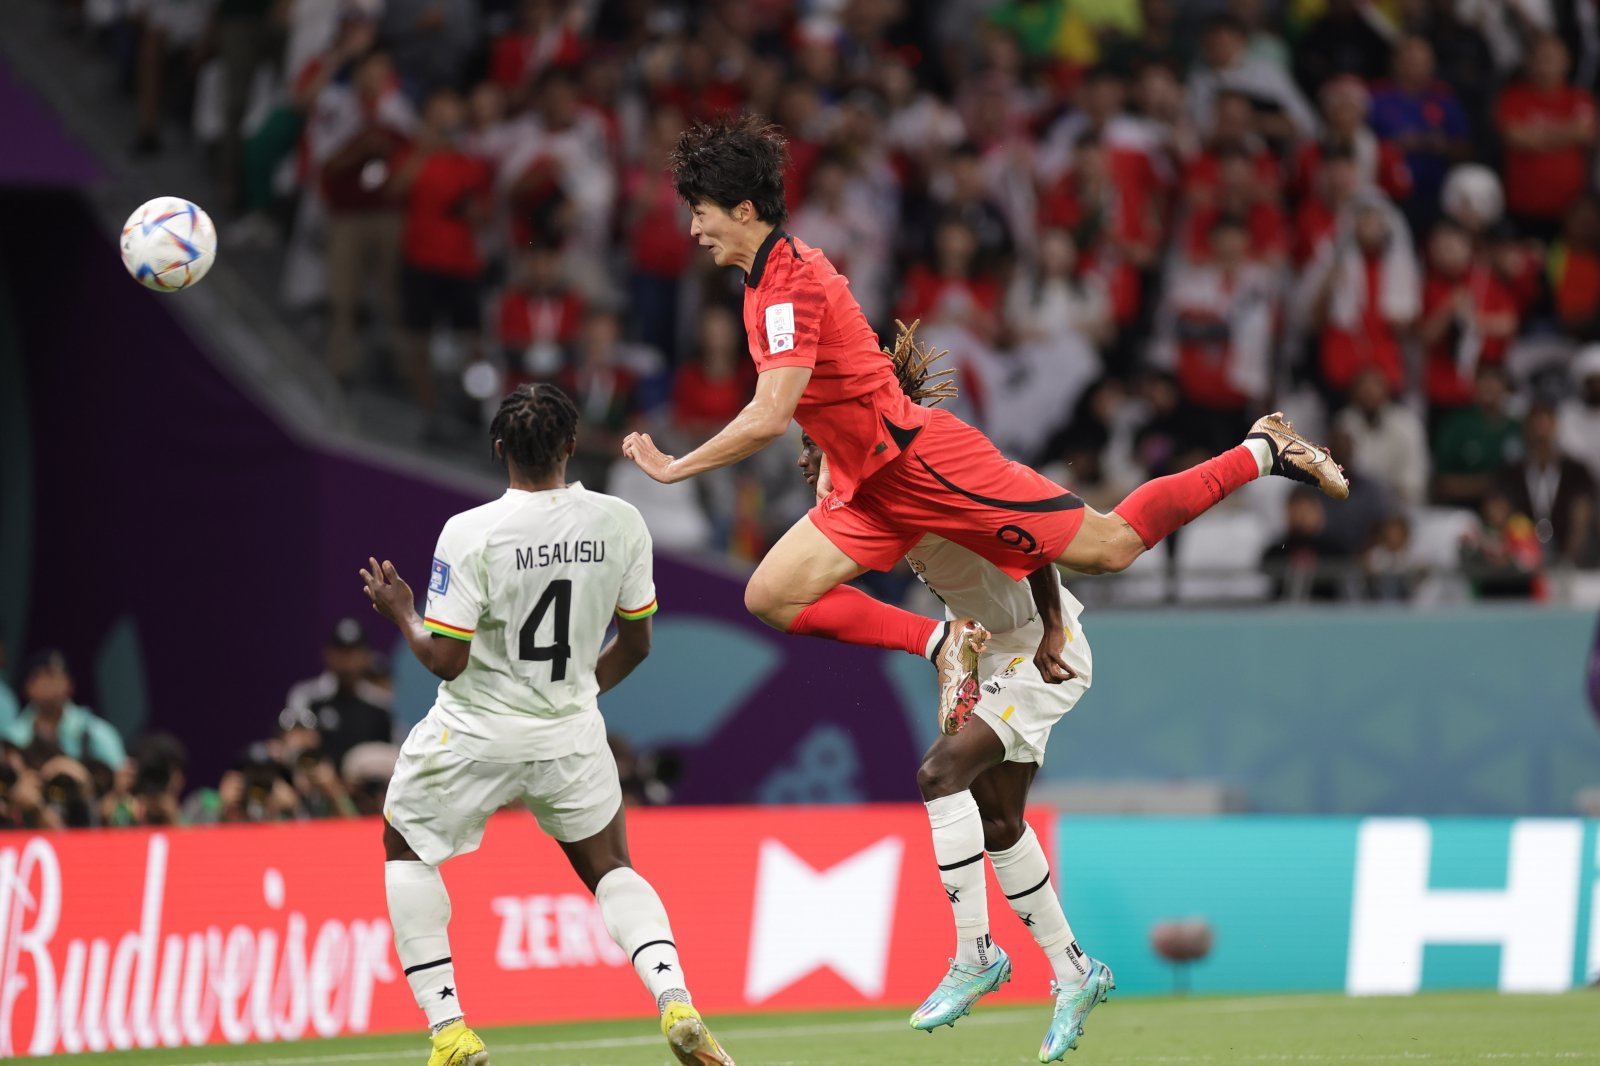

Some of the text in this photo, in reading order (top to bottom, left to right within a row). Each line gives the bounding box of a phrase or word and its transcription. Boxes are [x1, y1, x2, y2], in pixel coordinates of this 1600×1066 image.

[516, 541, 605, 570] M.SALISU
[997, 525, 1036, 554] 9
[519, 579, 572, 682] 4
[0, 836, 397, 1058] Budweiser
